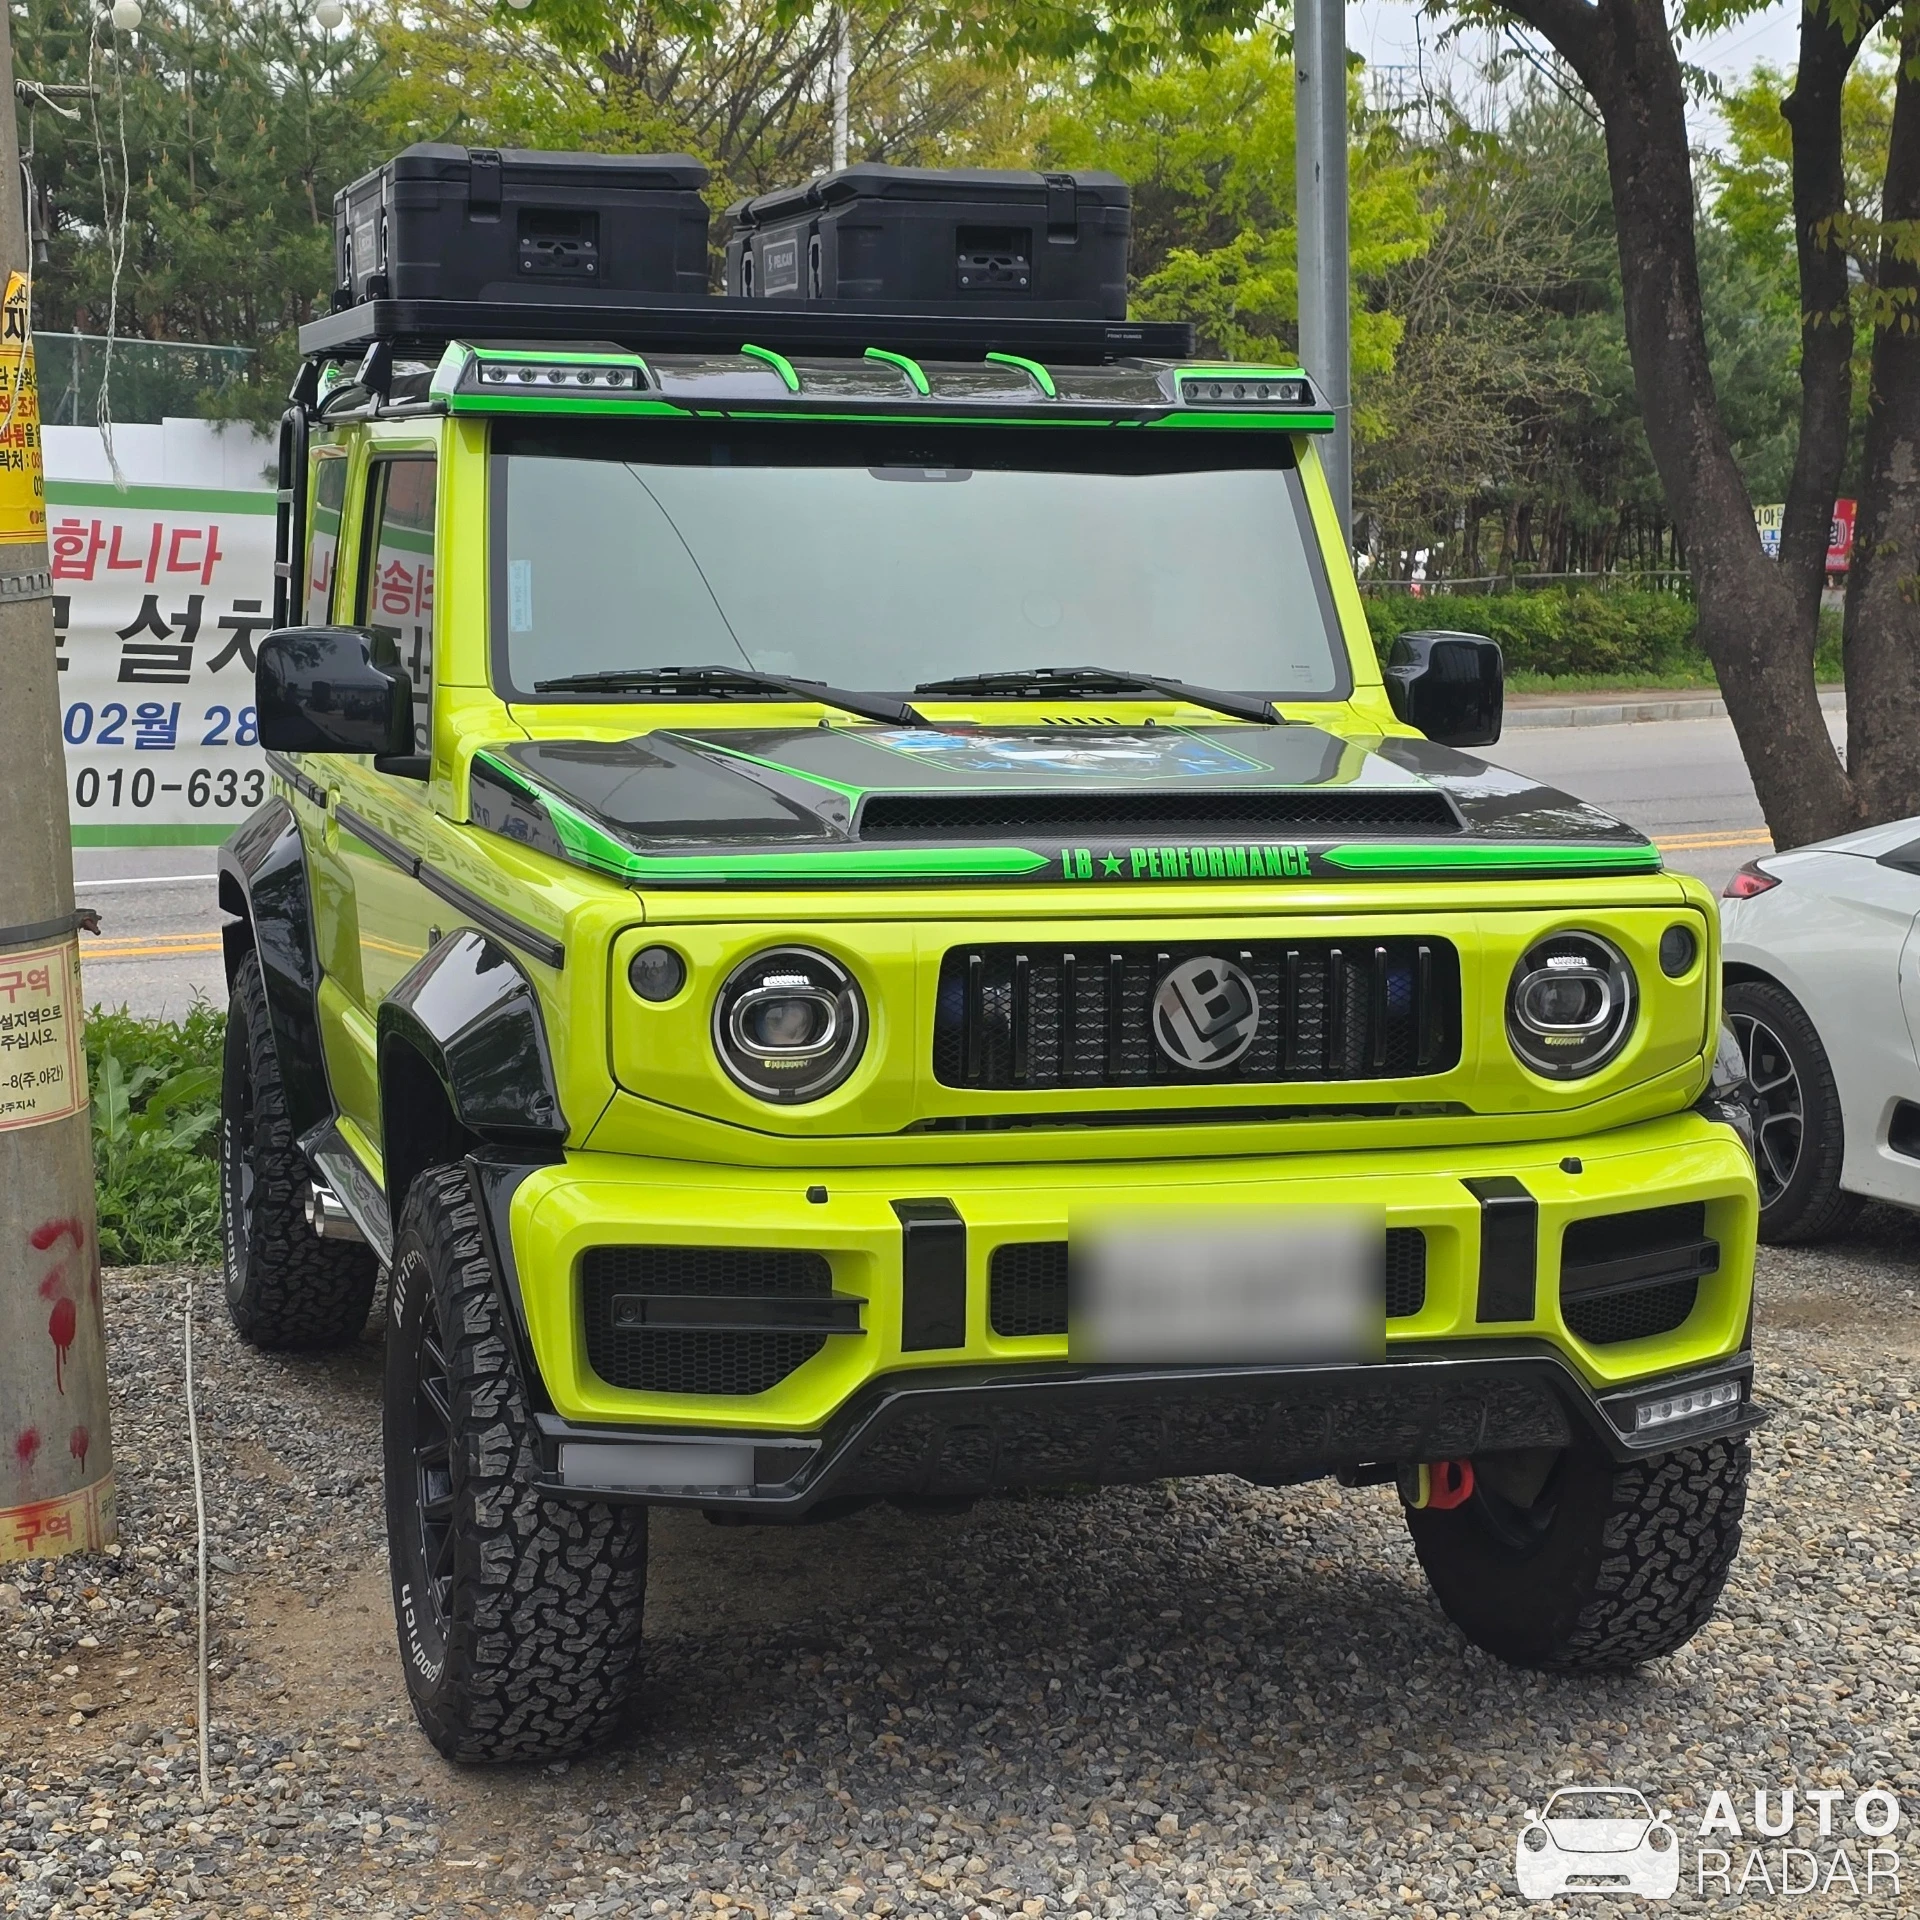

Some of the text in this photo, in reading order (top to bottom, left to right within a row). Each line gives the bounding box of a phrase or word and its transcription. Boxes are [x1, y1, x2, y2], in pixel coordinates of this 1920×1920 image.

[53, 518, 222, 585] 합니다
[1061, 846, 1312, 880] LB PERFORMANCE
[224, 1117, 238, 1284] BFGoodrich
[14, 1510, 72, 1552] 구역
